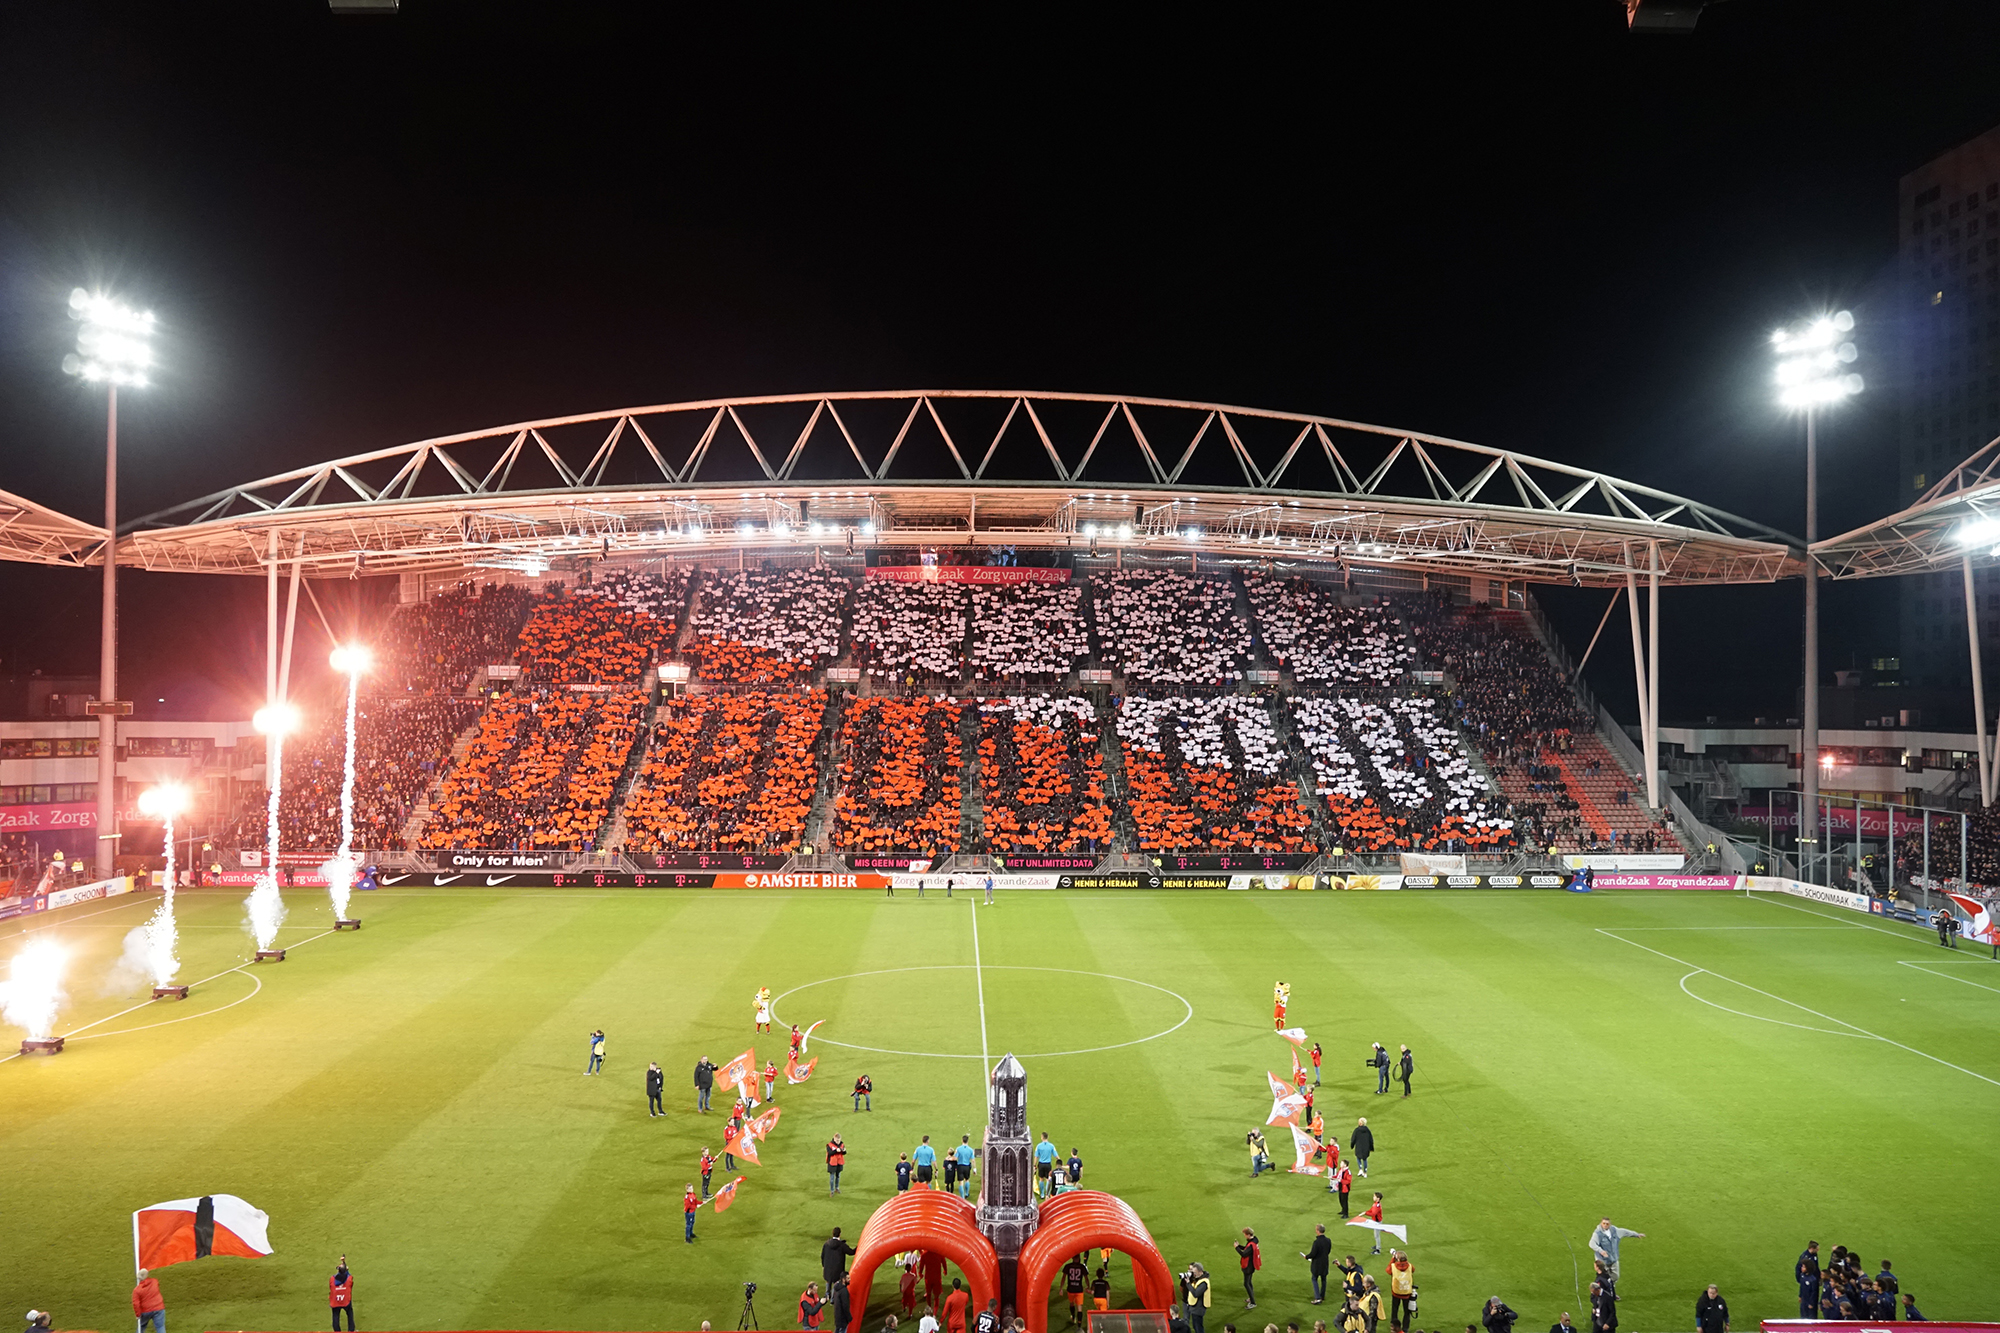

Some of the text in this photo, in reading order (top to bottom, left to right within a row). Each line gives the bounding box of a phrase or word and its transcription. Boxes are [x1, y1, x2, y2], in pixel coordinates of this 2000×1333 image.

[869, 569, 895, 580] Zorg
[896, 571, 918, 580] van
[936, 568, 965, 580] Zaak
[973, 568, 1066, 582] Zorg van de Zaak
[50, 810, 90, 826] Zorg
[1860, 816, 1898, 835] Zorg
[452, 855, 485, 868] Only
[487, 855, 509, 866] for
[854, 858, 870, 868] MIS
[871, 858, 895, 868] GEEN
[1006, 859, 1094, 868] MET UNLIMITED DATA
[222, 874, 240, 883] van
[241, 872, 252, 883] de
[759, 874, 858, 888] AMSTEL BIER
[894, 878, 916, 888] Zorg
[934, 877, 944, 886] de
[1016, 877, 1027, 886] de
[1028, 877, 1050, 886] Zaak
[1600, 878, 1615, 887] van
[1616, 877, 1628, 886] de
[1628, 877, 1650, 886] Zaak
[1657, 876, 1729, 888] Zorg van de Zaak
[1074, 880, 1139, 888] HENRI & HERMAN
[1163, 880, 1186, 888] HENRI
[1187, 880, 1193, 888] &
[1193, 880, 1227, 888] HERMAN
[1804, 888, 1850, 906] SCHOONMAAK
[1055, 1173, 1064, 1184] 18
[1069, 1268, 1081, 1281] 32
[978, 1316, 992, 1333] 22
